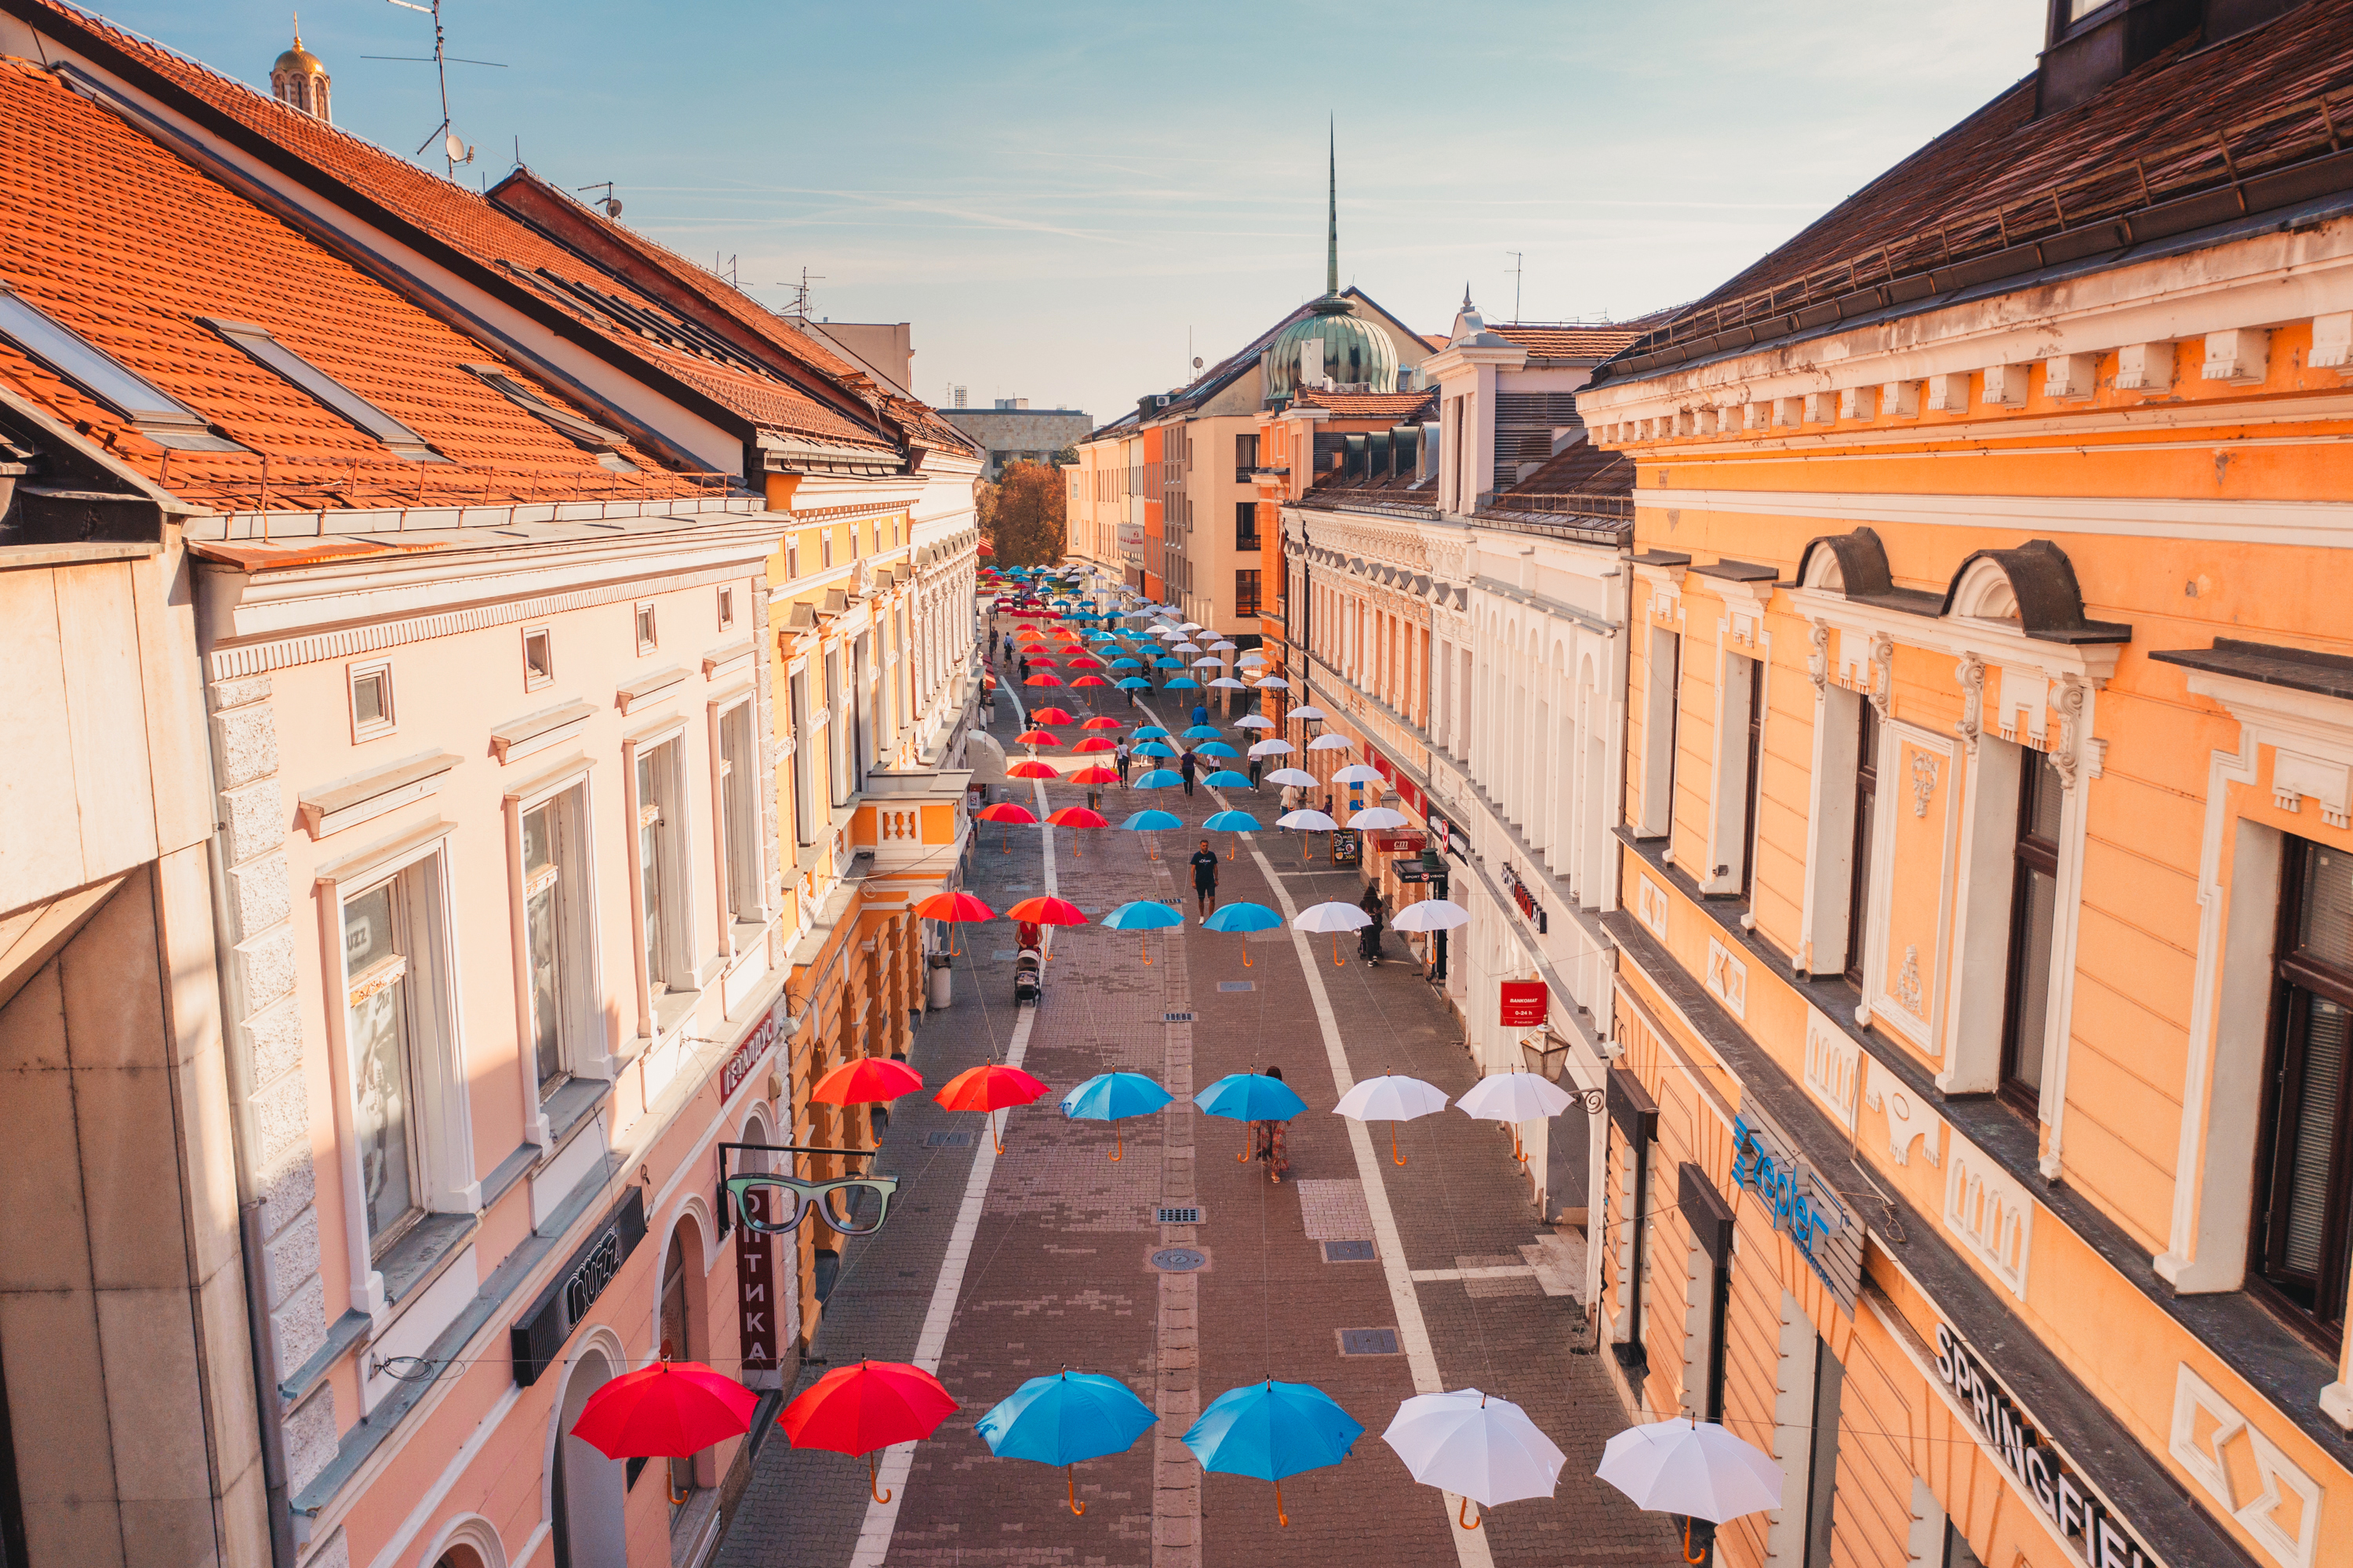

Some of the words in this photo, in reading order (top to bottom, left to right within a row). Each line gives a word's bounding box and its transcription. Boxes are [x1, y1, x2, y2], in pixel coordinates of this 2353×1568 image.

[346, 927, 367, 951] UZZ
[1750, 1133, 1829, 1252] zepter
[566, 1231, 620, 1323] BUZZ
[1935, 1322, 2149, 1568] SPRINGFIE
